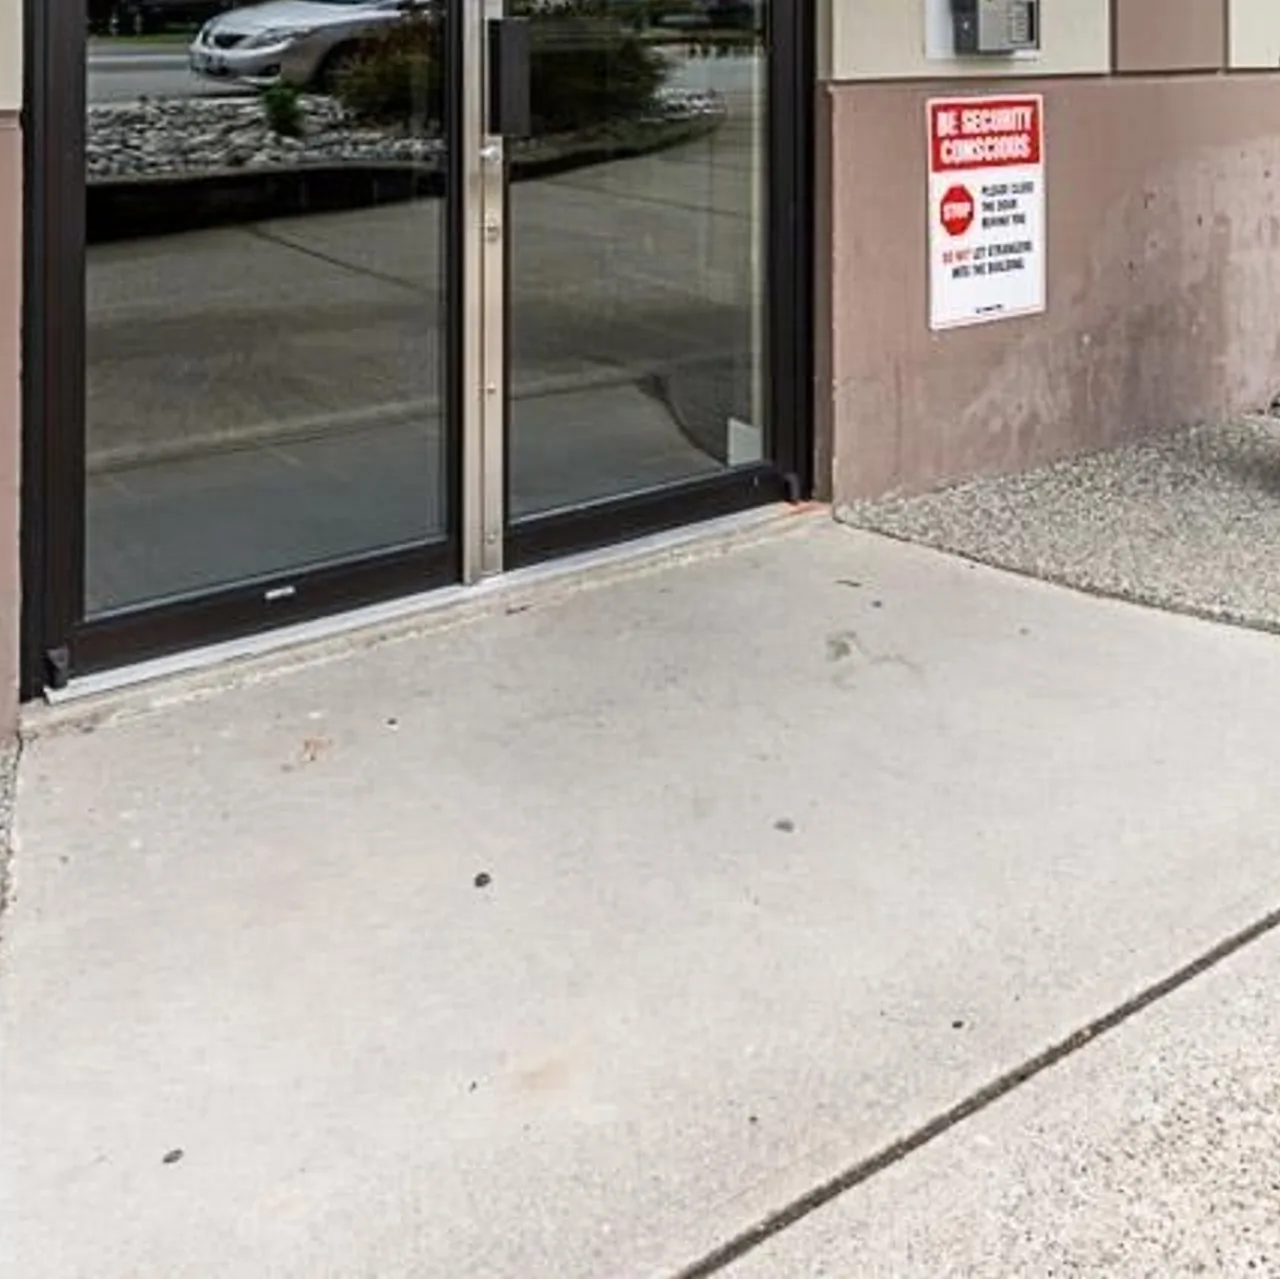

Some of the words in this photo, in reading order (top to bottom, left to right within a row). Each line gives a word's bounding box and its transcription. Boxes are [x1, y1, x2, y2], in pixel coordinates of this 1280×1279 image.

[937, 109, 960, 137] BE
[961, 106, 1033, 134] SECURITY
[941, 133, 1031, 164] CONSCIOUS
[943, 201, 971, 221] STOP
